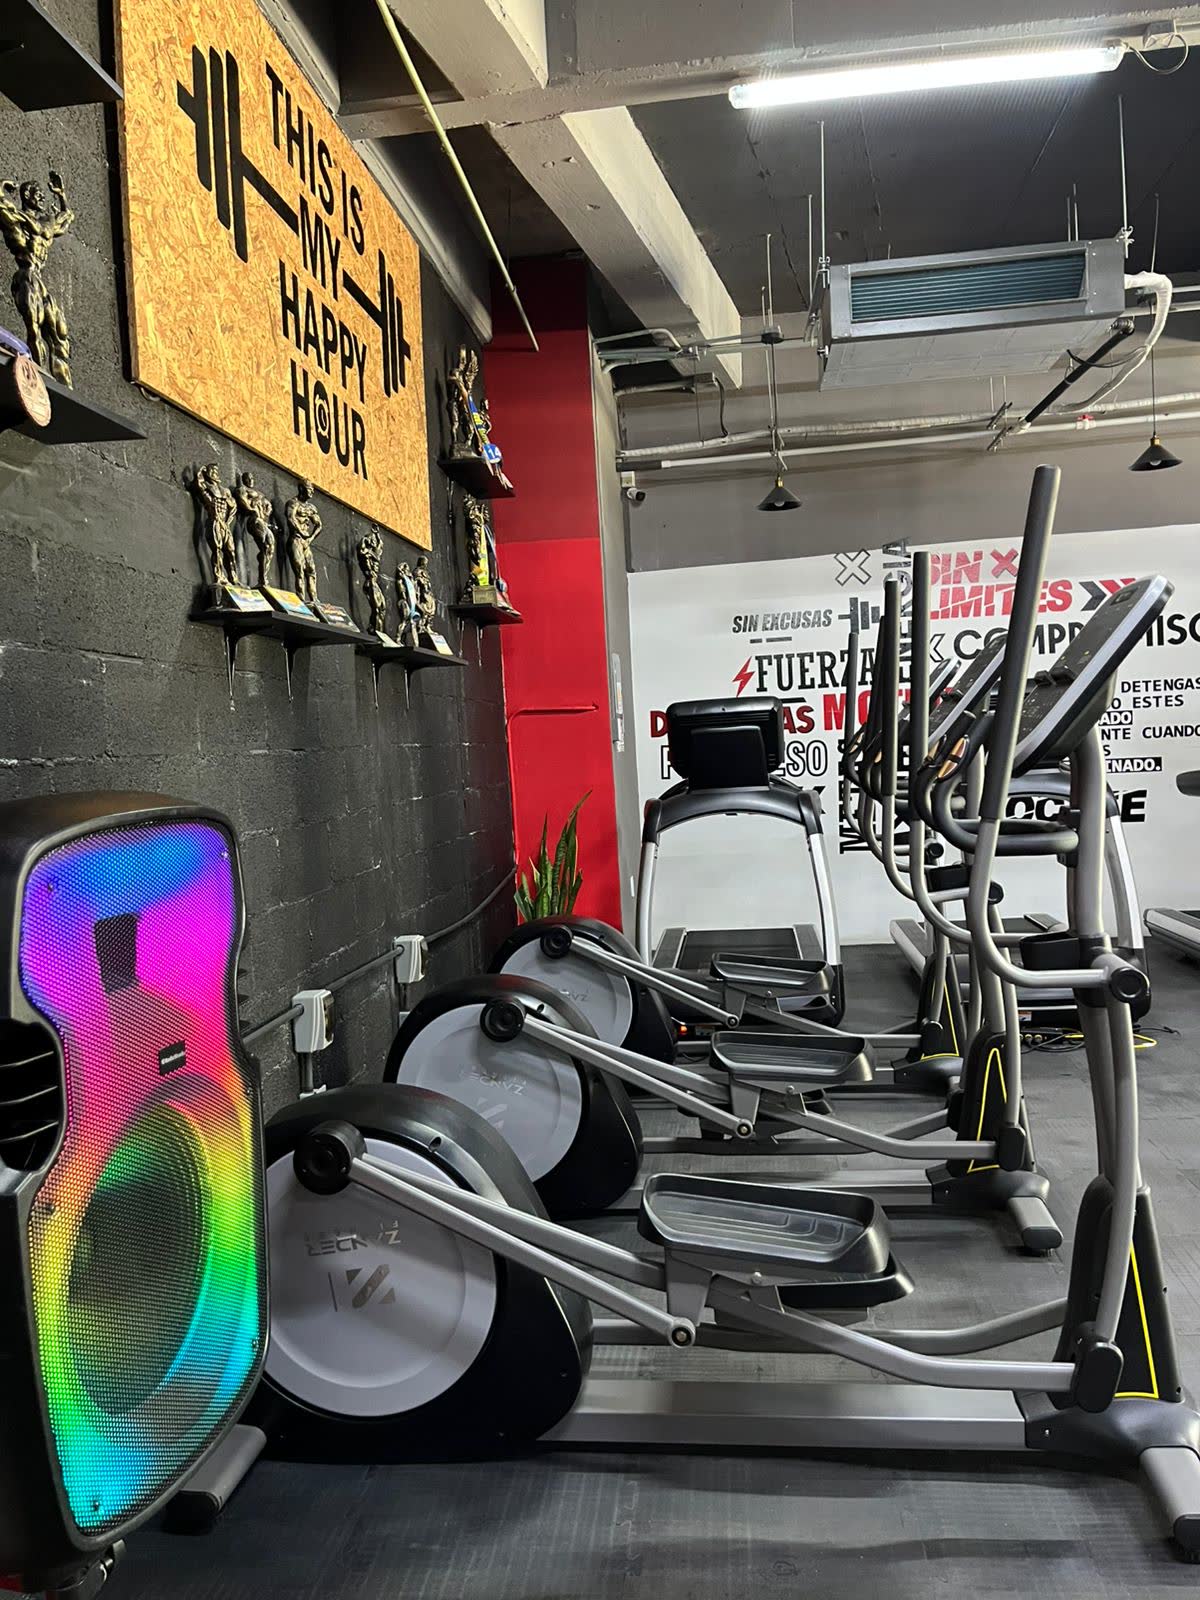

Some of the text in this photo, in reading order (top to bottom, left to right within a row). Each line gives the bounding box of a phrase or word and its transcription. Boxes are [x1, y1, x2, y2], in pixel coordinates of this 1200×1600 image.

[265, 61, 365, 256] THIS IS
[299, 194, 341, 301] MY
[279, 258, 368, 404] HAPPY
[291, 358, 369, 480] HOUR
[732, 608, 833, 633] SIN EXCUSAS
[930, 550, 984, 584] SIN
[1132, 694, 1184, 709] ESTES
